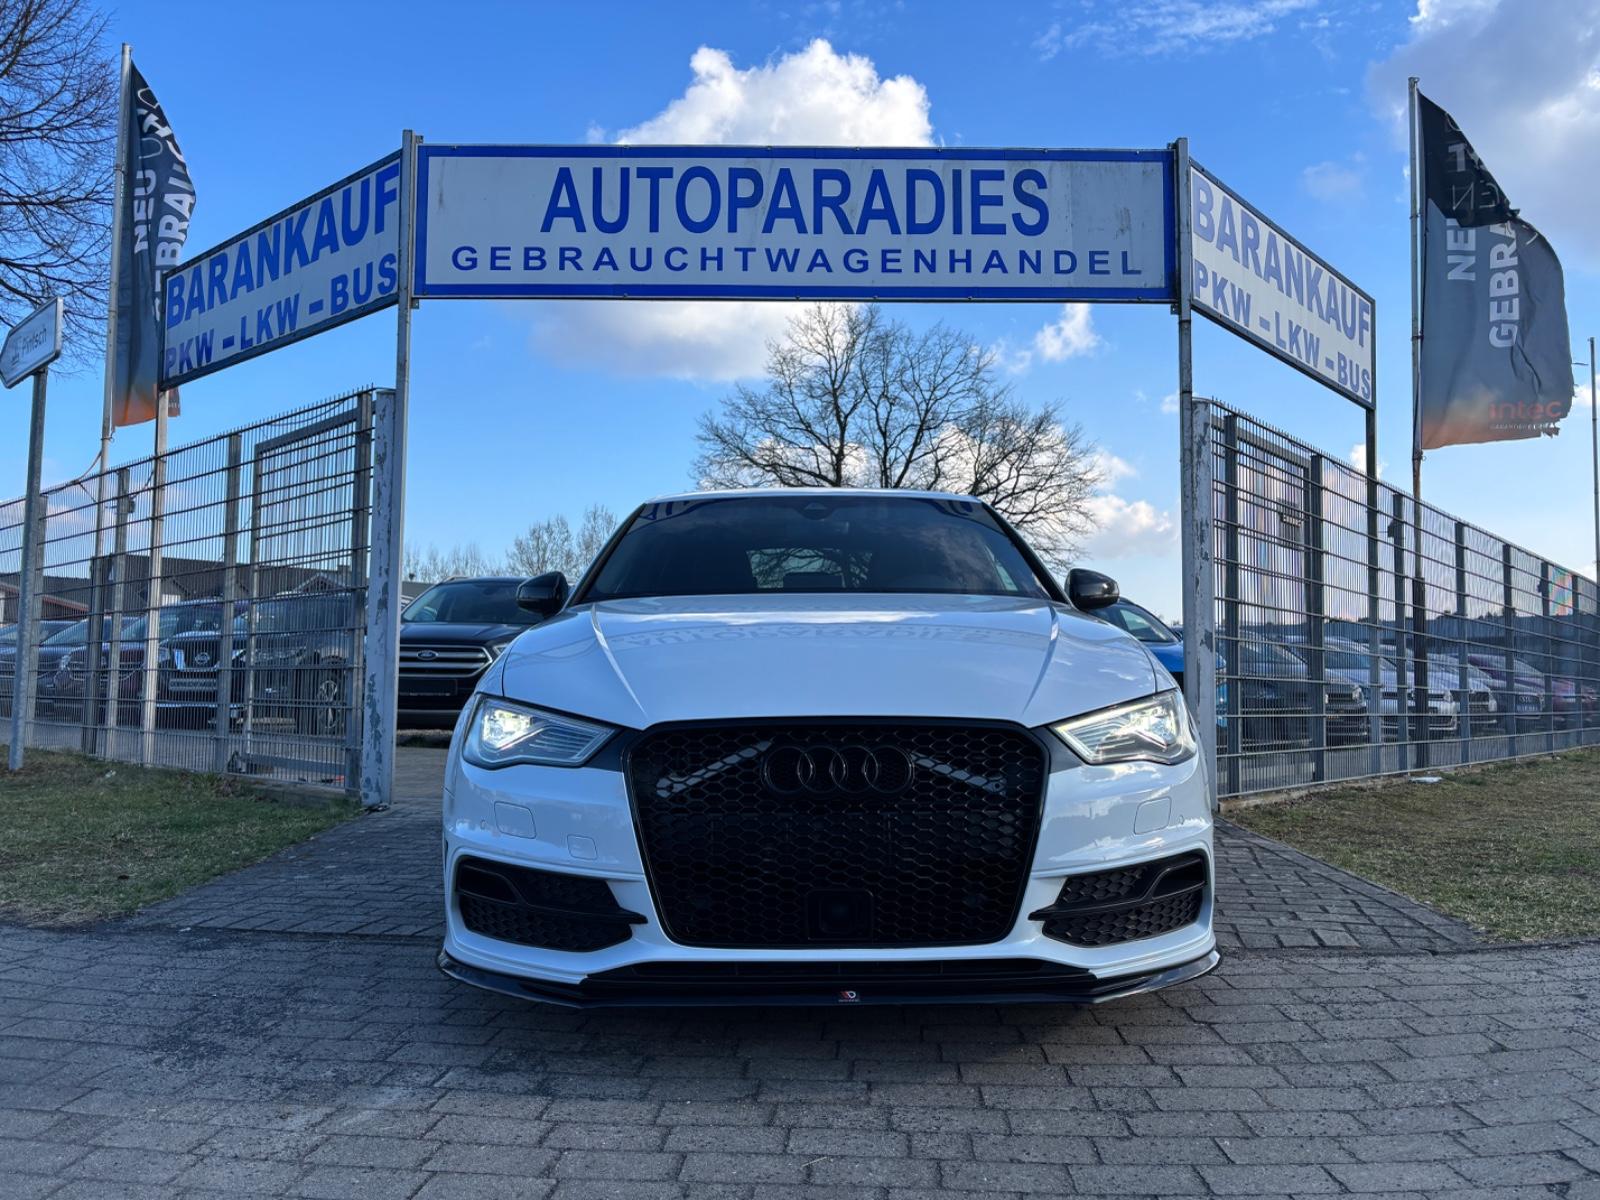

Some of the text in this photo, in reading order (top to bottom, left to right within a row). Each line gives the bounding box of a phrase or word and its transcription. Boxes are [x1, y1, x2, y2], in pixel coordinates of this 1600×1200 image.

[133, 169, 157, 254] NEU
[166, 162, 400, 330] BARANKAUF
[540, 165, 1050, 238] AUTOPARADIES
[450, 245, 1144, 277] GEBRAUCHTWAGENHANDEL
[1192, 172, 1371, 348] BARANKAUF
[165, 332, 214, 376] PKW
[330, 253, 398, 316] BUS
[1194, 258, 1252, 327] PKW
[1337, 354, 1372, 401] BUS
[1488, 400, 1562, 420] intec
